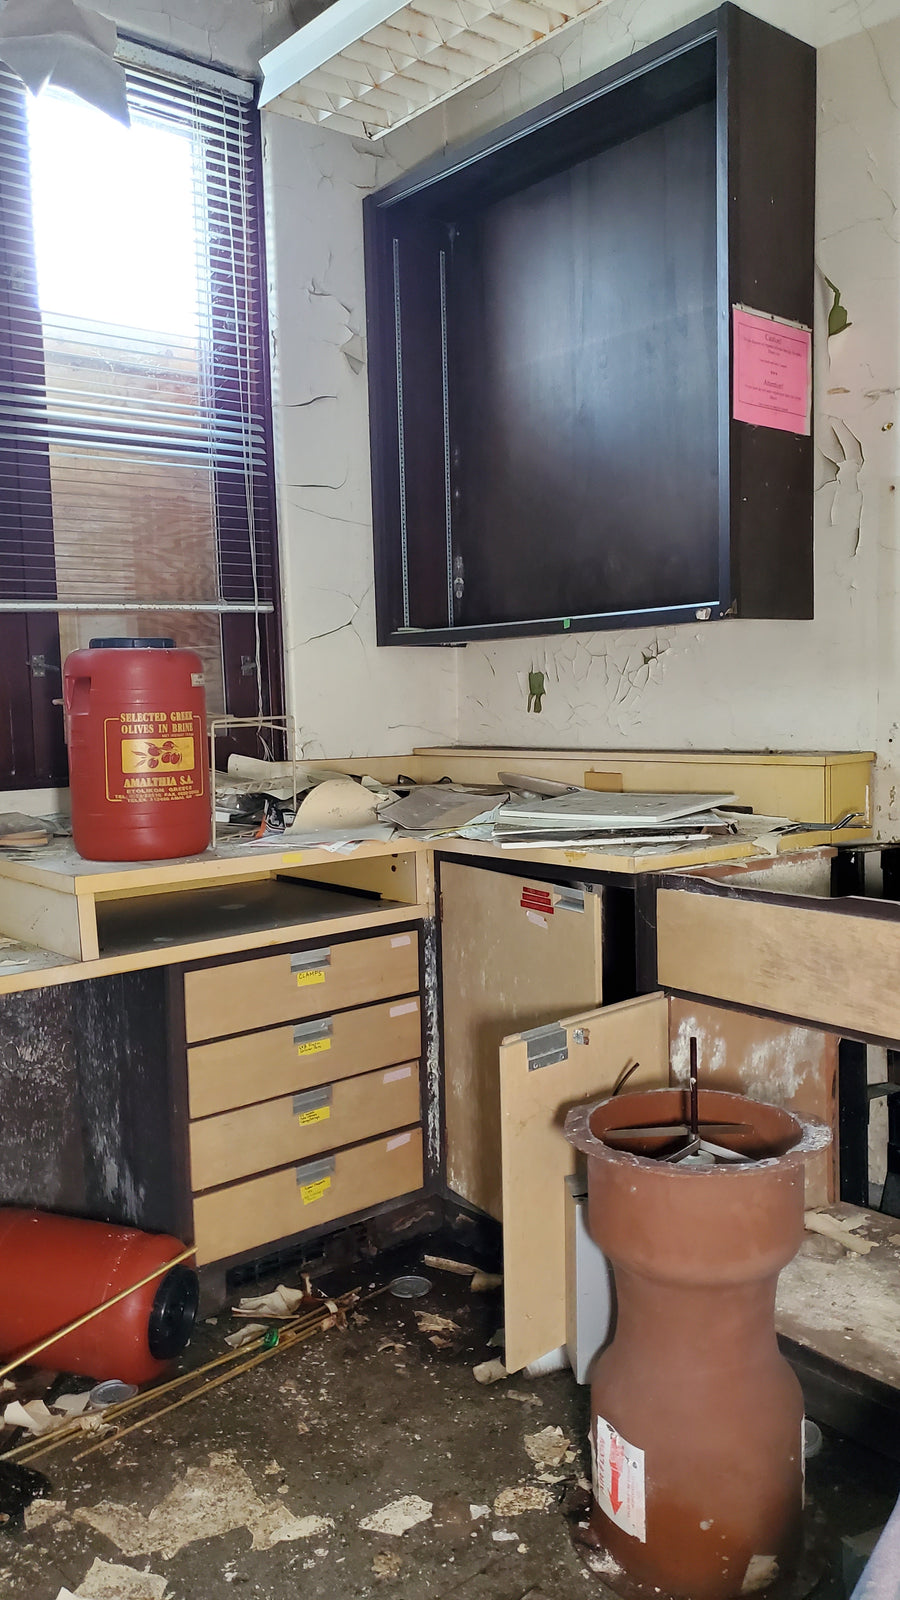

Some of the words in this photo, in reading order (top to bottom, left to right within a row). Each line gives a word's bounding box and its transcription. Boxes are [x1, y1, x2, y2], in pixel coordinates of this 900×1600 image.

[120, 712, 167, 722] SELECTED
[170, 711, 193, 722] GREEK
[121, 723, 155, 734] OLIVES
[158, 723, 168, 733] IN
[172, 722, 194, 733] BRINE
[298, 970, 322, 980] CLAMPS
